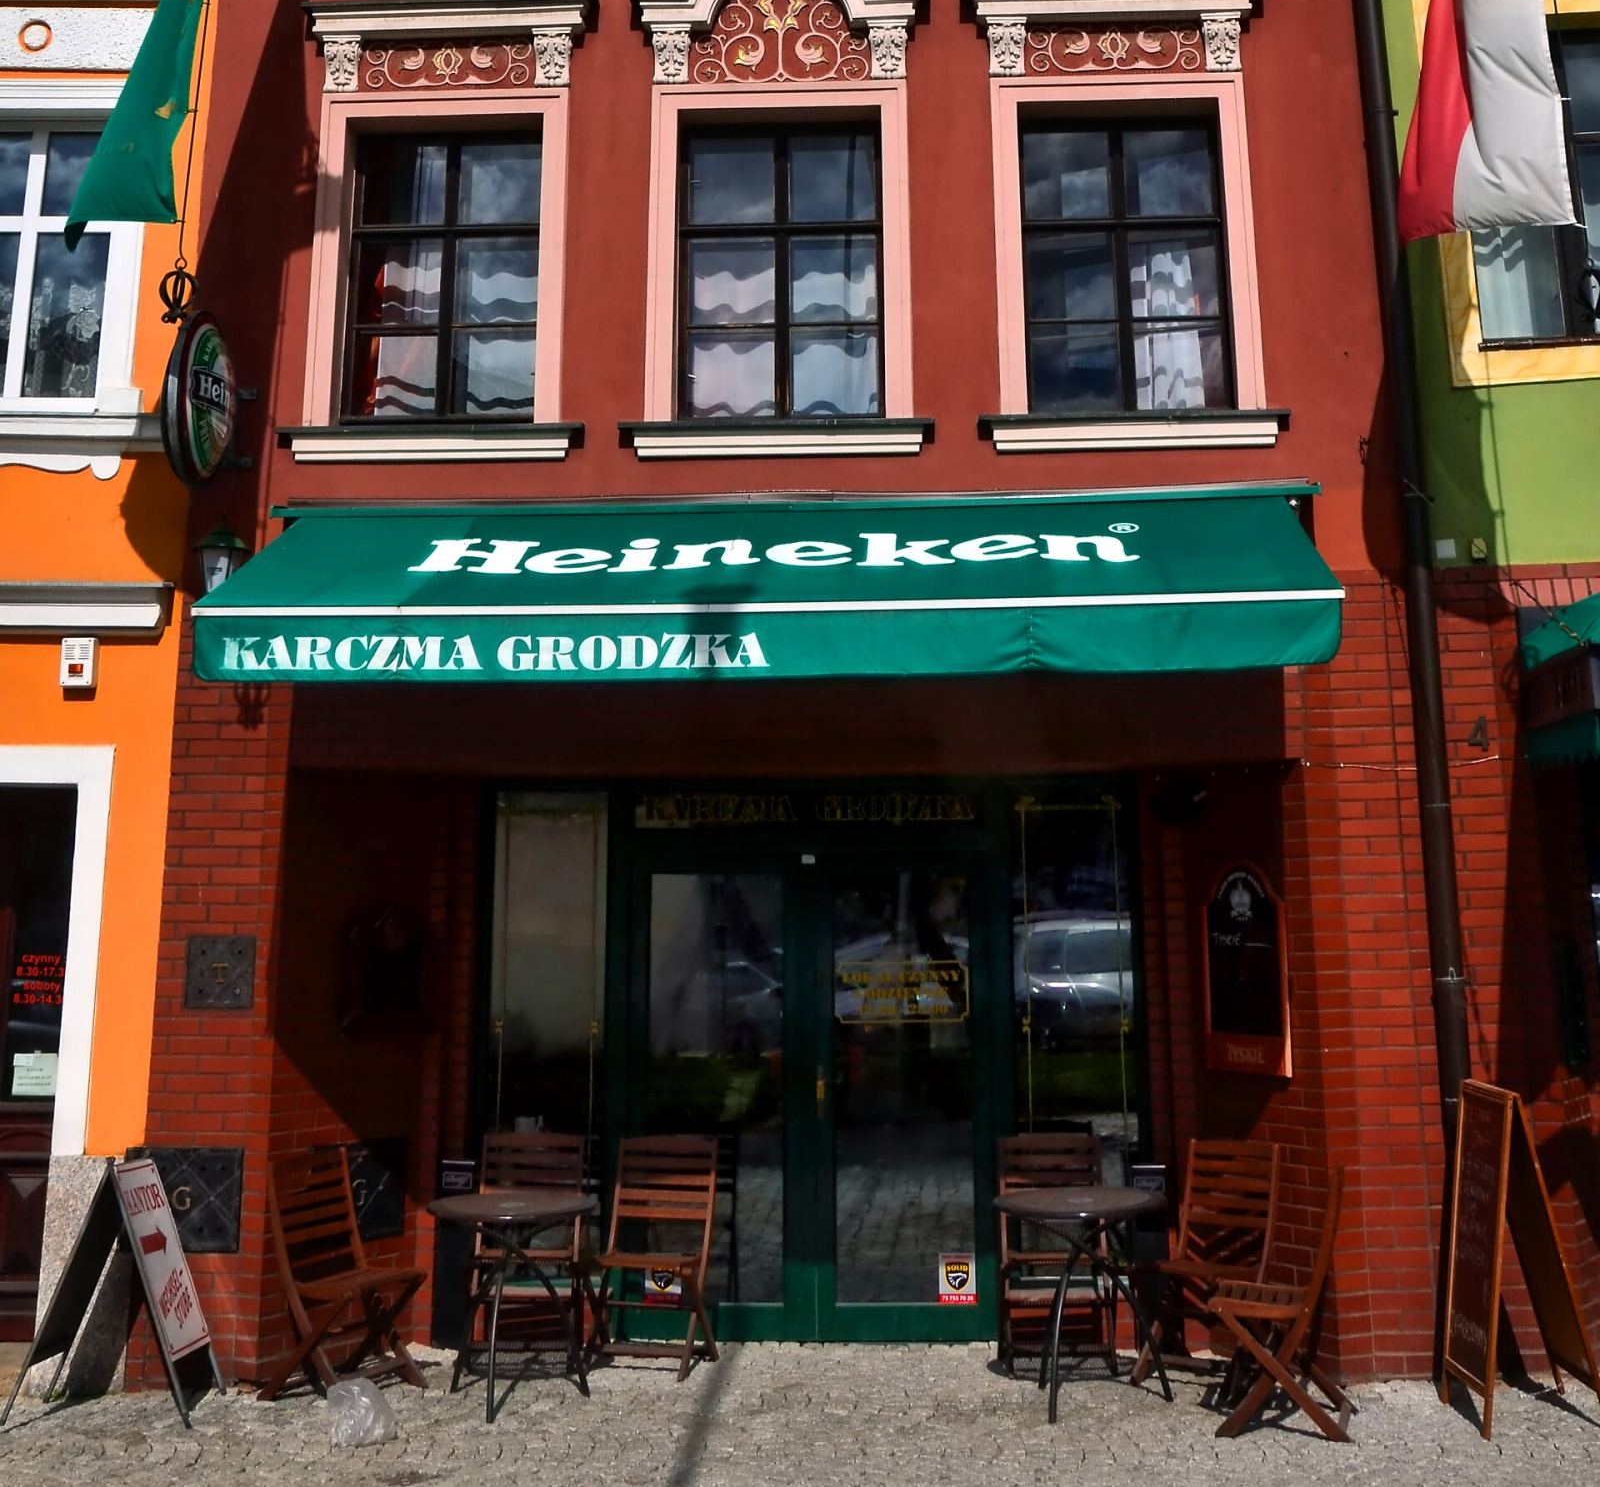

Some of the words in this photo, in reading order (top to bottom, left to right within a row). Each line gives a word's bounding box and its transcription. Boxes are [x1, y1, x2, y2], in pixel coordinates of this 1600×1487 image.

[407, 533, 1140, 575] Heineken
[220, 634, 483, 674] KARCZMA
[497, 631, 770, 672] GRODZKA
[1468, 716, 1490, 752] 4
[642, 793, 798, 822] KARCZMA
[815, 793, 975, 821] GRODZKA
[22, 954, 61, 964] czynny
[16, 966, 65, 978] 8.30-17.3
[23, 980, 62, 992] soboty
[13, 994, 64, 1005] 8.30-14.3
[1226, 1042, 1265, 1064] TYSKIE
[123, 1183, 165, 1215] KANTOR
[171, 1186, 192, 1210] G
